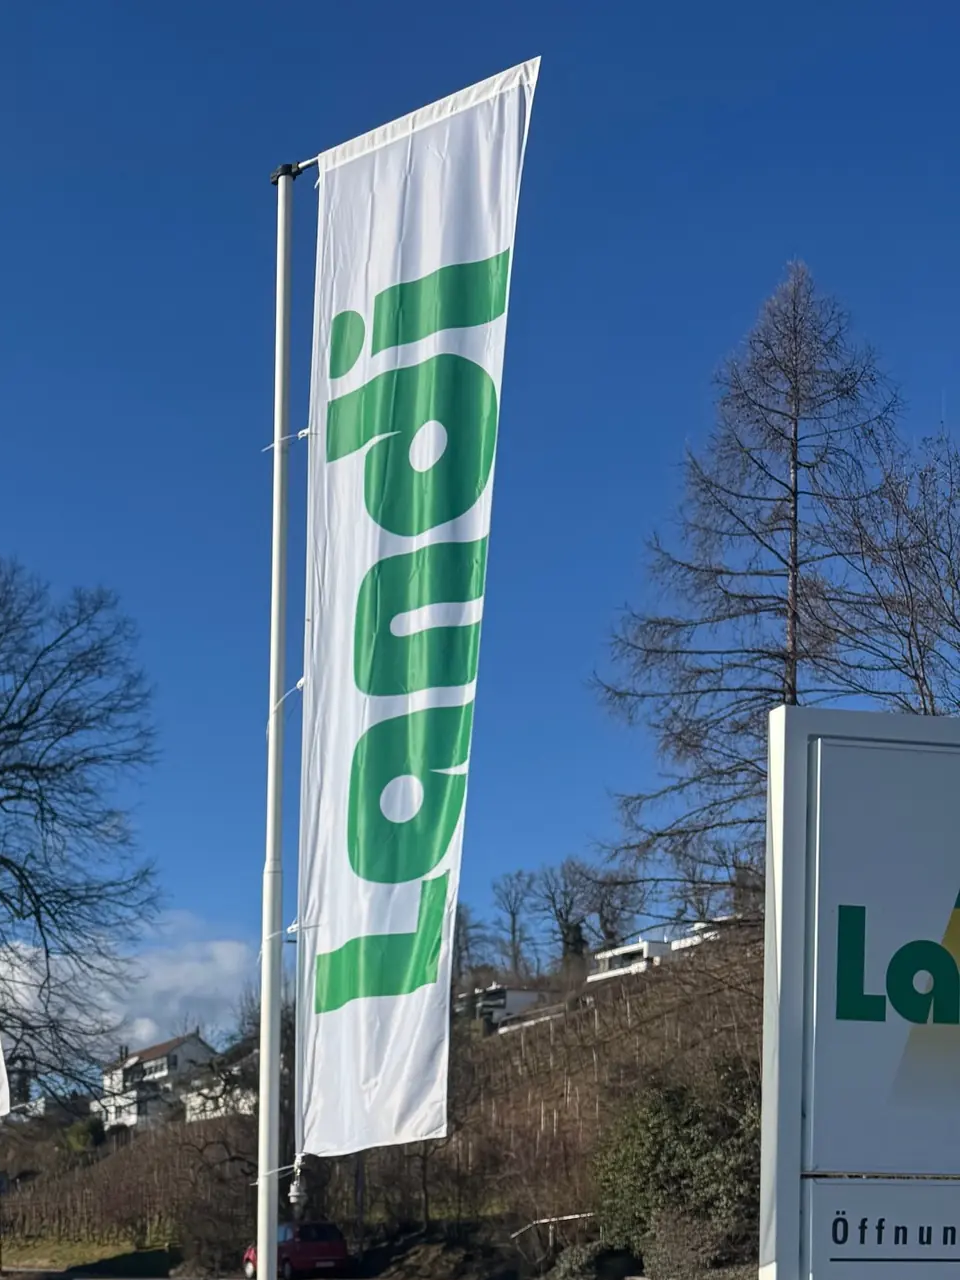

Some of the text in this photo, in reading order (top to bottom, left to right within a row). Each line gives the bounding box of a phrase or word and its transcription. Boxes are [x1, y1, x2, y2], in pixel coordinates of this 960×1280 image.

[314, 248, 512, 1015] Landi
[836, 905, 960, 1025] La
[831, 1210, 957, 1246] Öffnun
